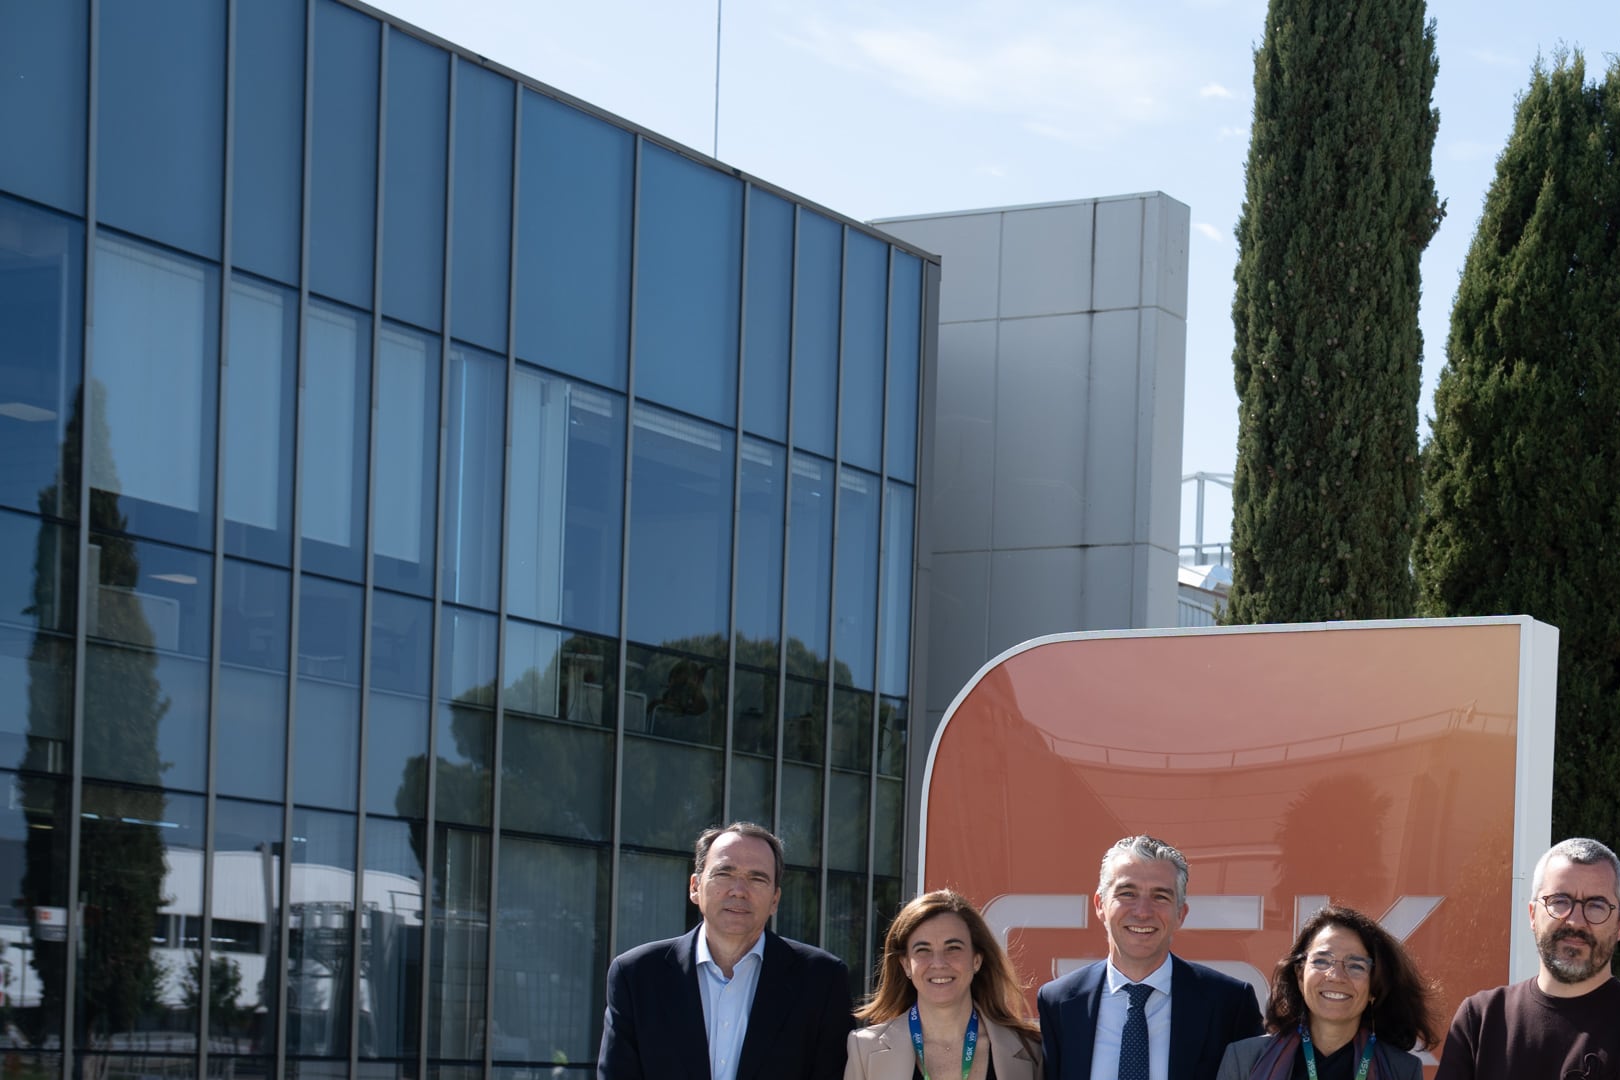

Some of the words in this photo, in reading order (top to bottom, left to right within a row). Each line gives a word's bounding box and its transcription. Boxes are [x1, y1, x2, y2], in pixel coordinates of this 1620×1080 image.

[965, 1046, 973, 1061] GSK
[1307, 1058, 1316, 1076] GSK
[1359, 1057, 1370, 1075] GSK
